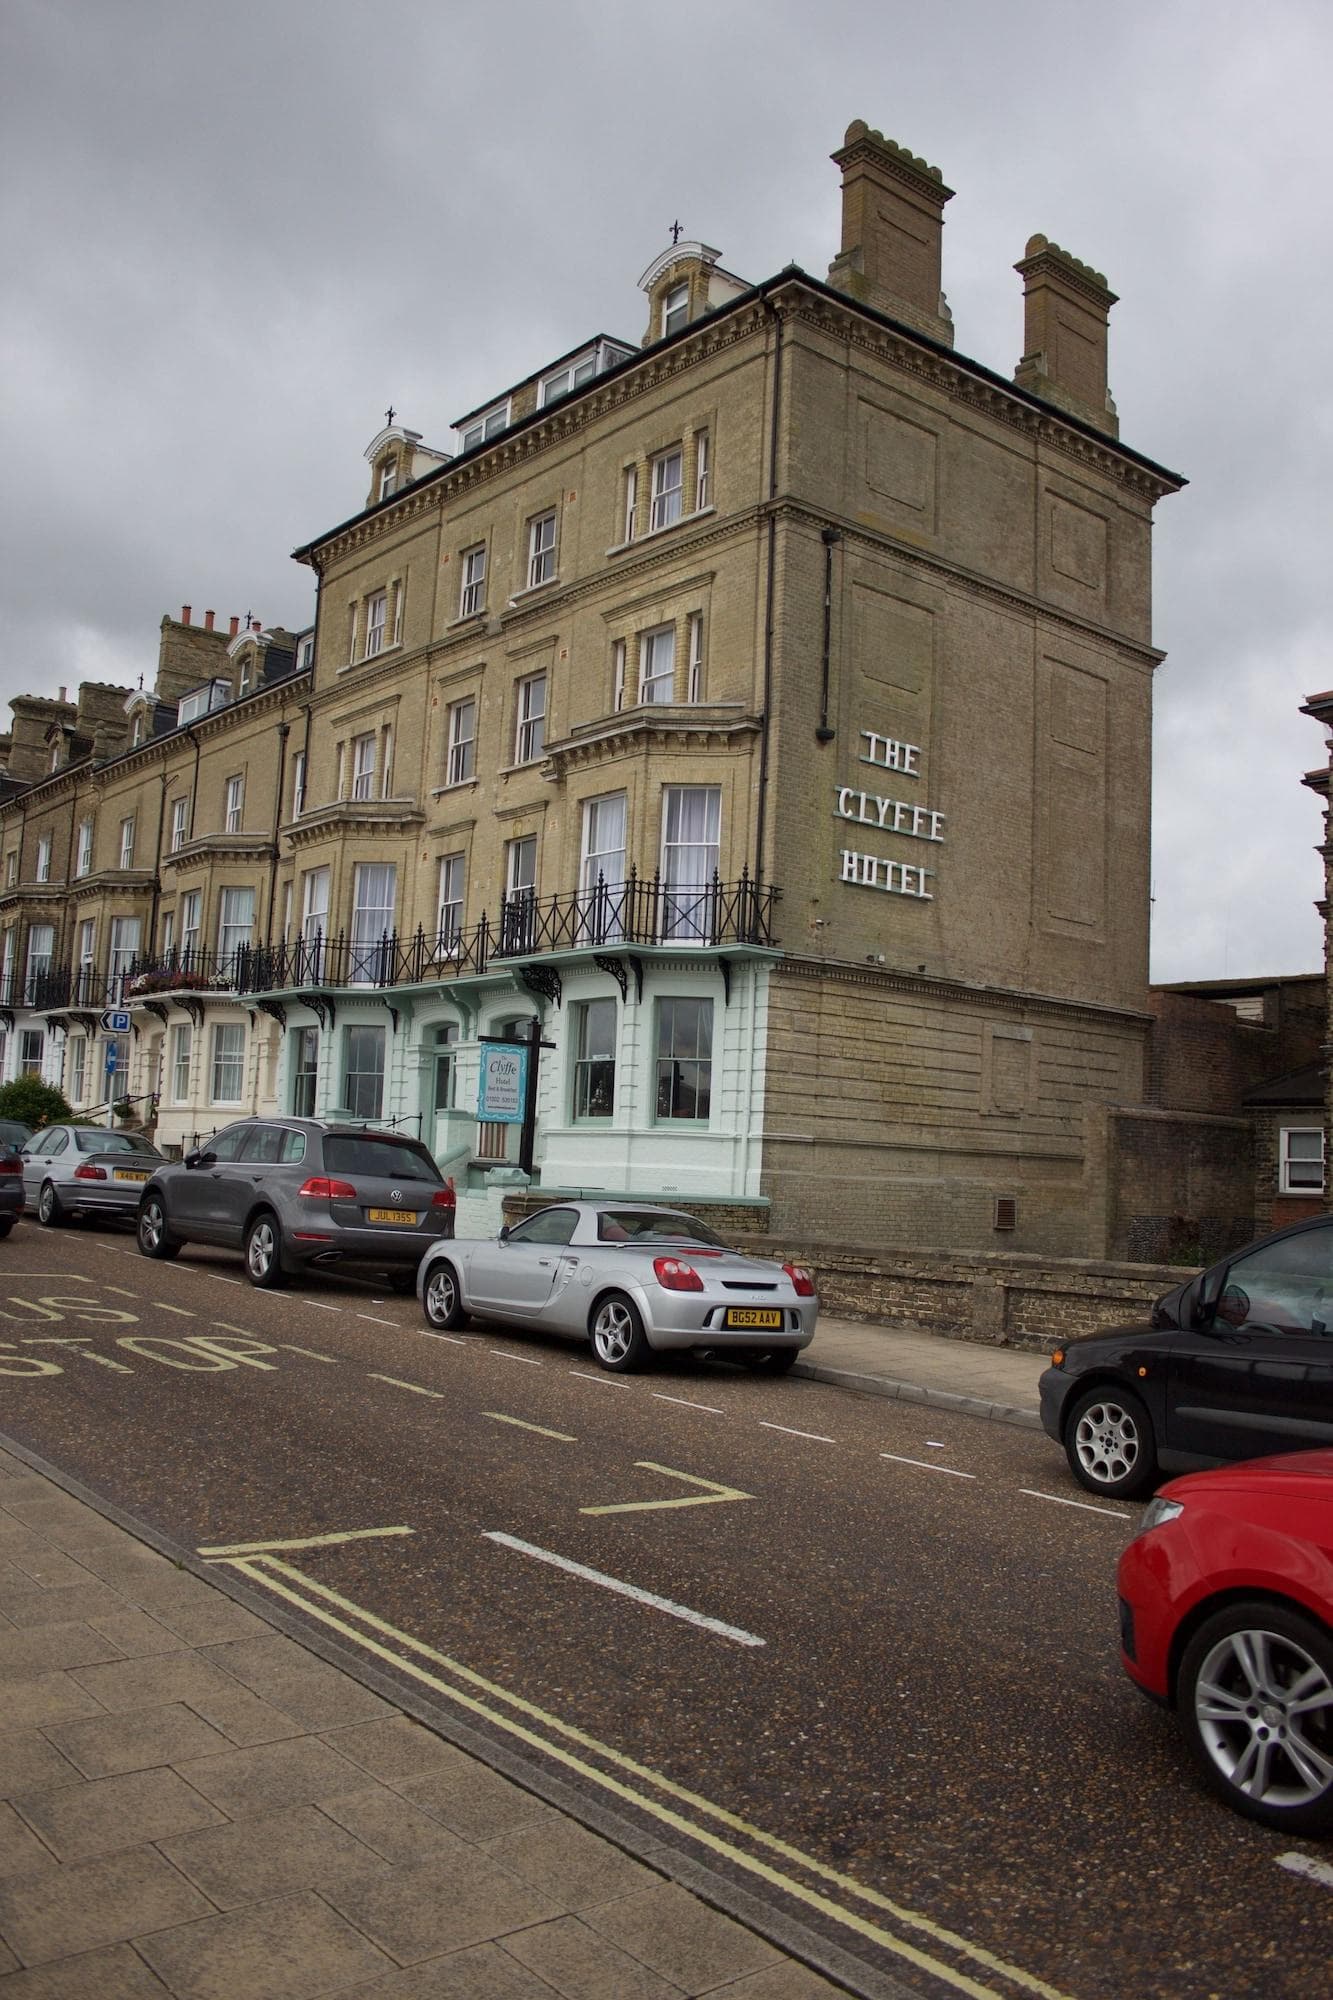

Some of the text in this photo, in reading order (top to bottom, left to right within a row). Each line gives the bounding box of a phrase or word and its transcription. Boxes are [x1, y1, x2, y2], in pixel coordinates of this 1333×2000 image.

[866, 731, 922, 774] THE
[838, 787, 945, 841] CLYFFE
[842, 849, 934, 901] HOTEL
[116, 1015, 126, 1028] P
[490, 1060, 517, 1075] Clyffe
[495, 1077, 511, 1085] Hotel
[375, 1210, 391, 1221] JUL
[732, 1311, 777, 1325] BG52 AAV
